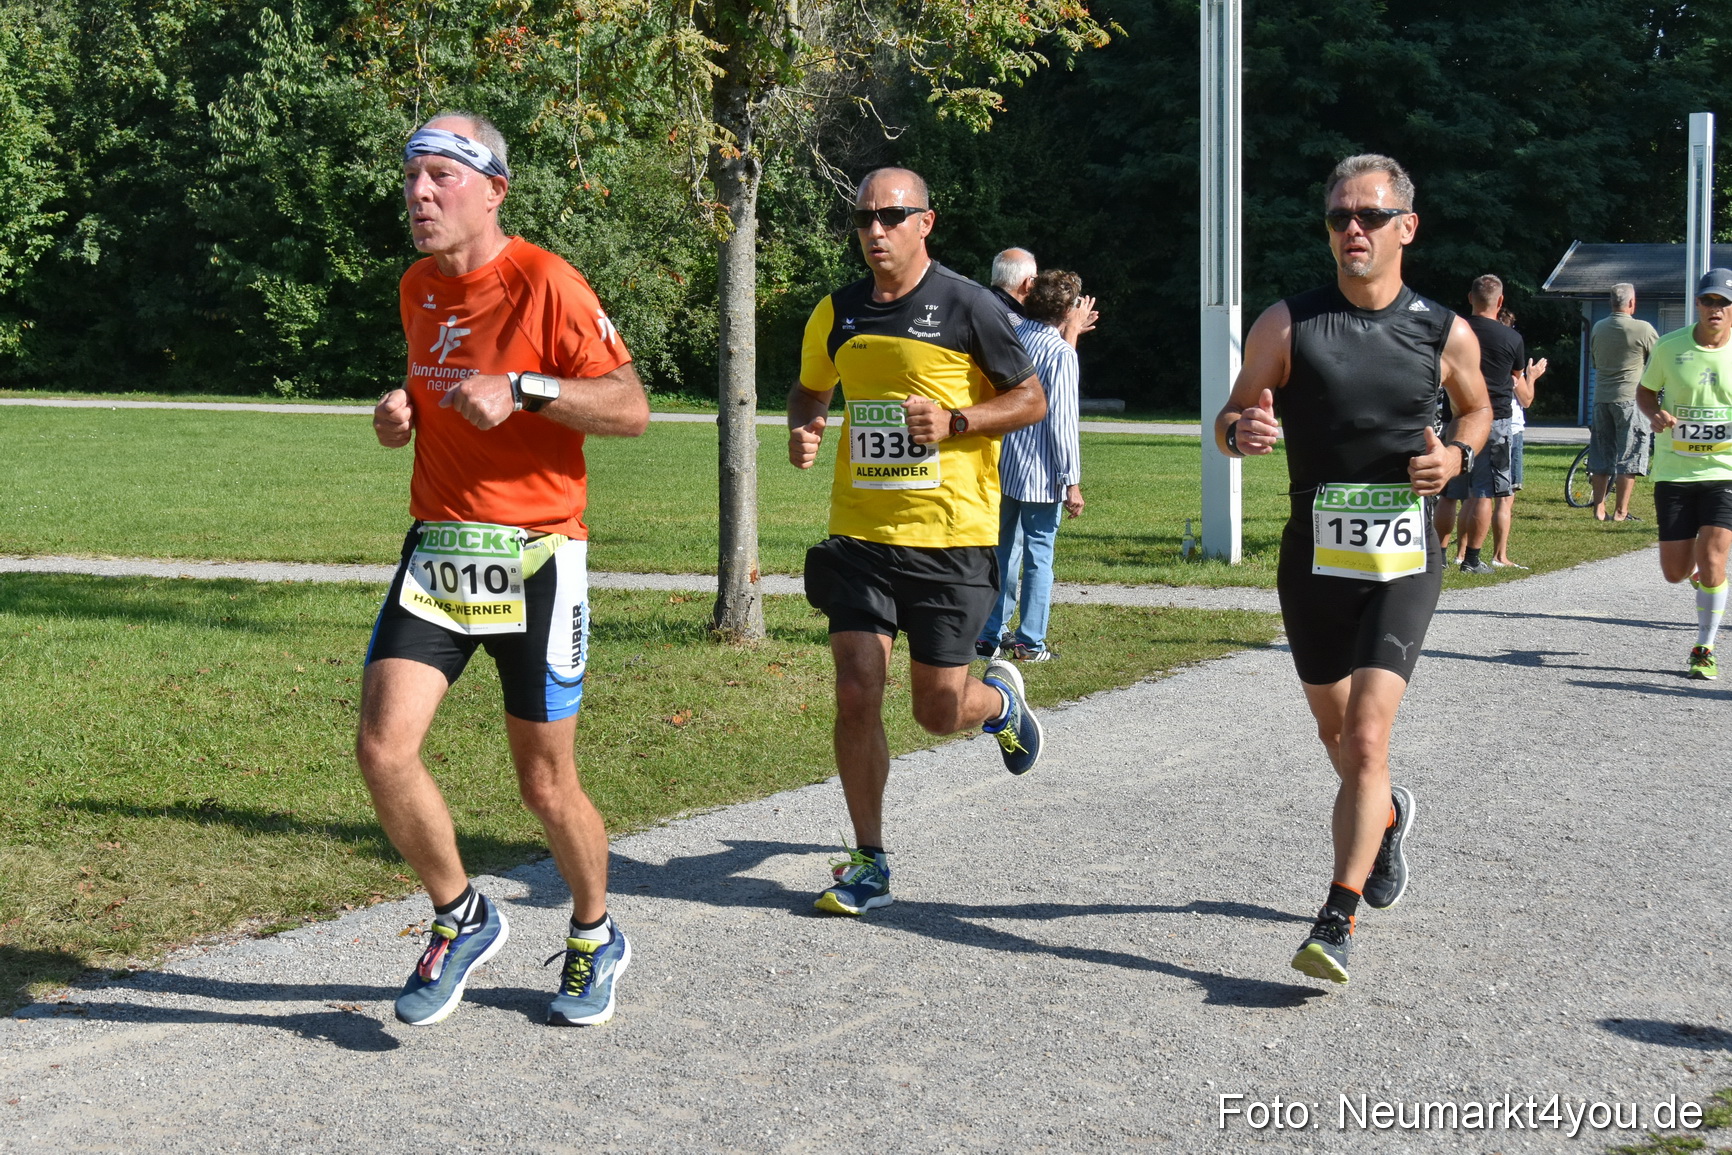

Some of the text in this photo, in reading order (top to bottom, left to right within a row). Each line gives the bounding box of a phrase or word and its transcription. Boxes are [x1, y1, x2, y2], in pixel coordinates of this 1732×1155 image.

[907, 326, 941, 338] Burgthann
[851, 341, 868, 350] Alex
[410, 362, 480, 378] funrunners
[855, 406, 906, 423] BOC
[1677, 408, 1726, 419] BOCK
[1678, 424, 1726, 440] 1258
[857, 432, 927, 459] 1338
[1688, 444, 1713, 452] PETR
[857, 467, 928, 477] ALEXANDER
[1325, 489, 1413, 508] BOCK
[425, 528, 508, 552] BOCK
[1328, 517, 1412, 547] 1376
[423, 560, 509, 595] 1010
[413, 593, 512, 616] HANS-WERNER
[571, 604, 583, 669] HUBER
